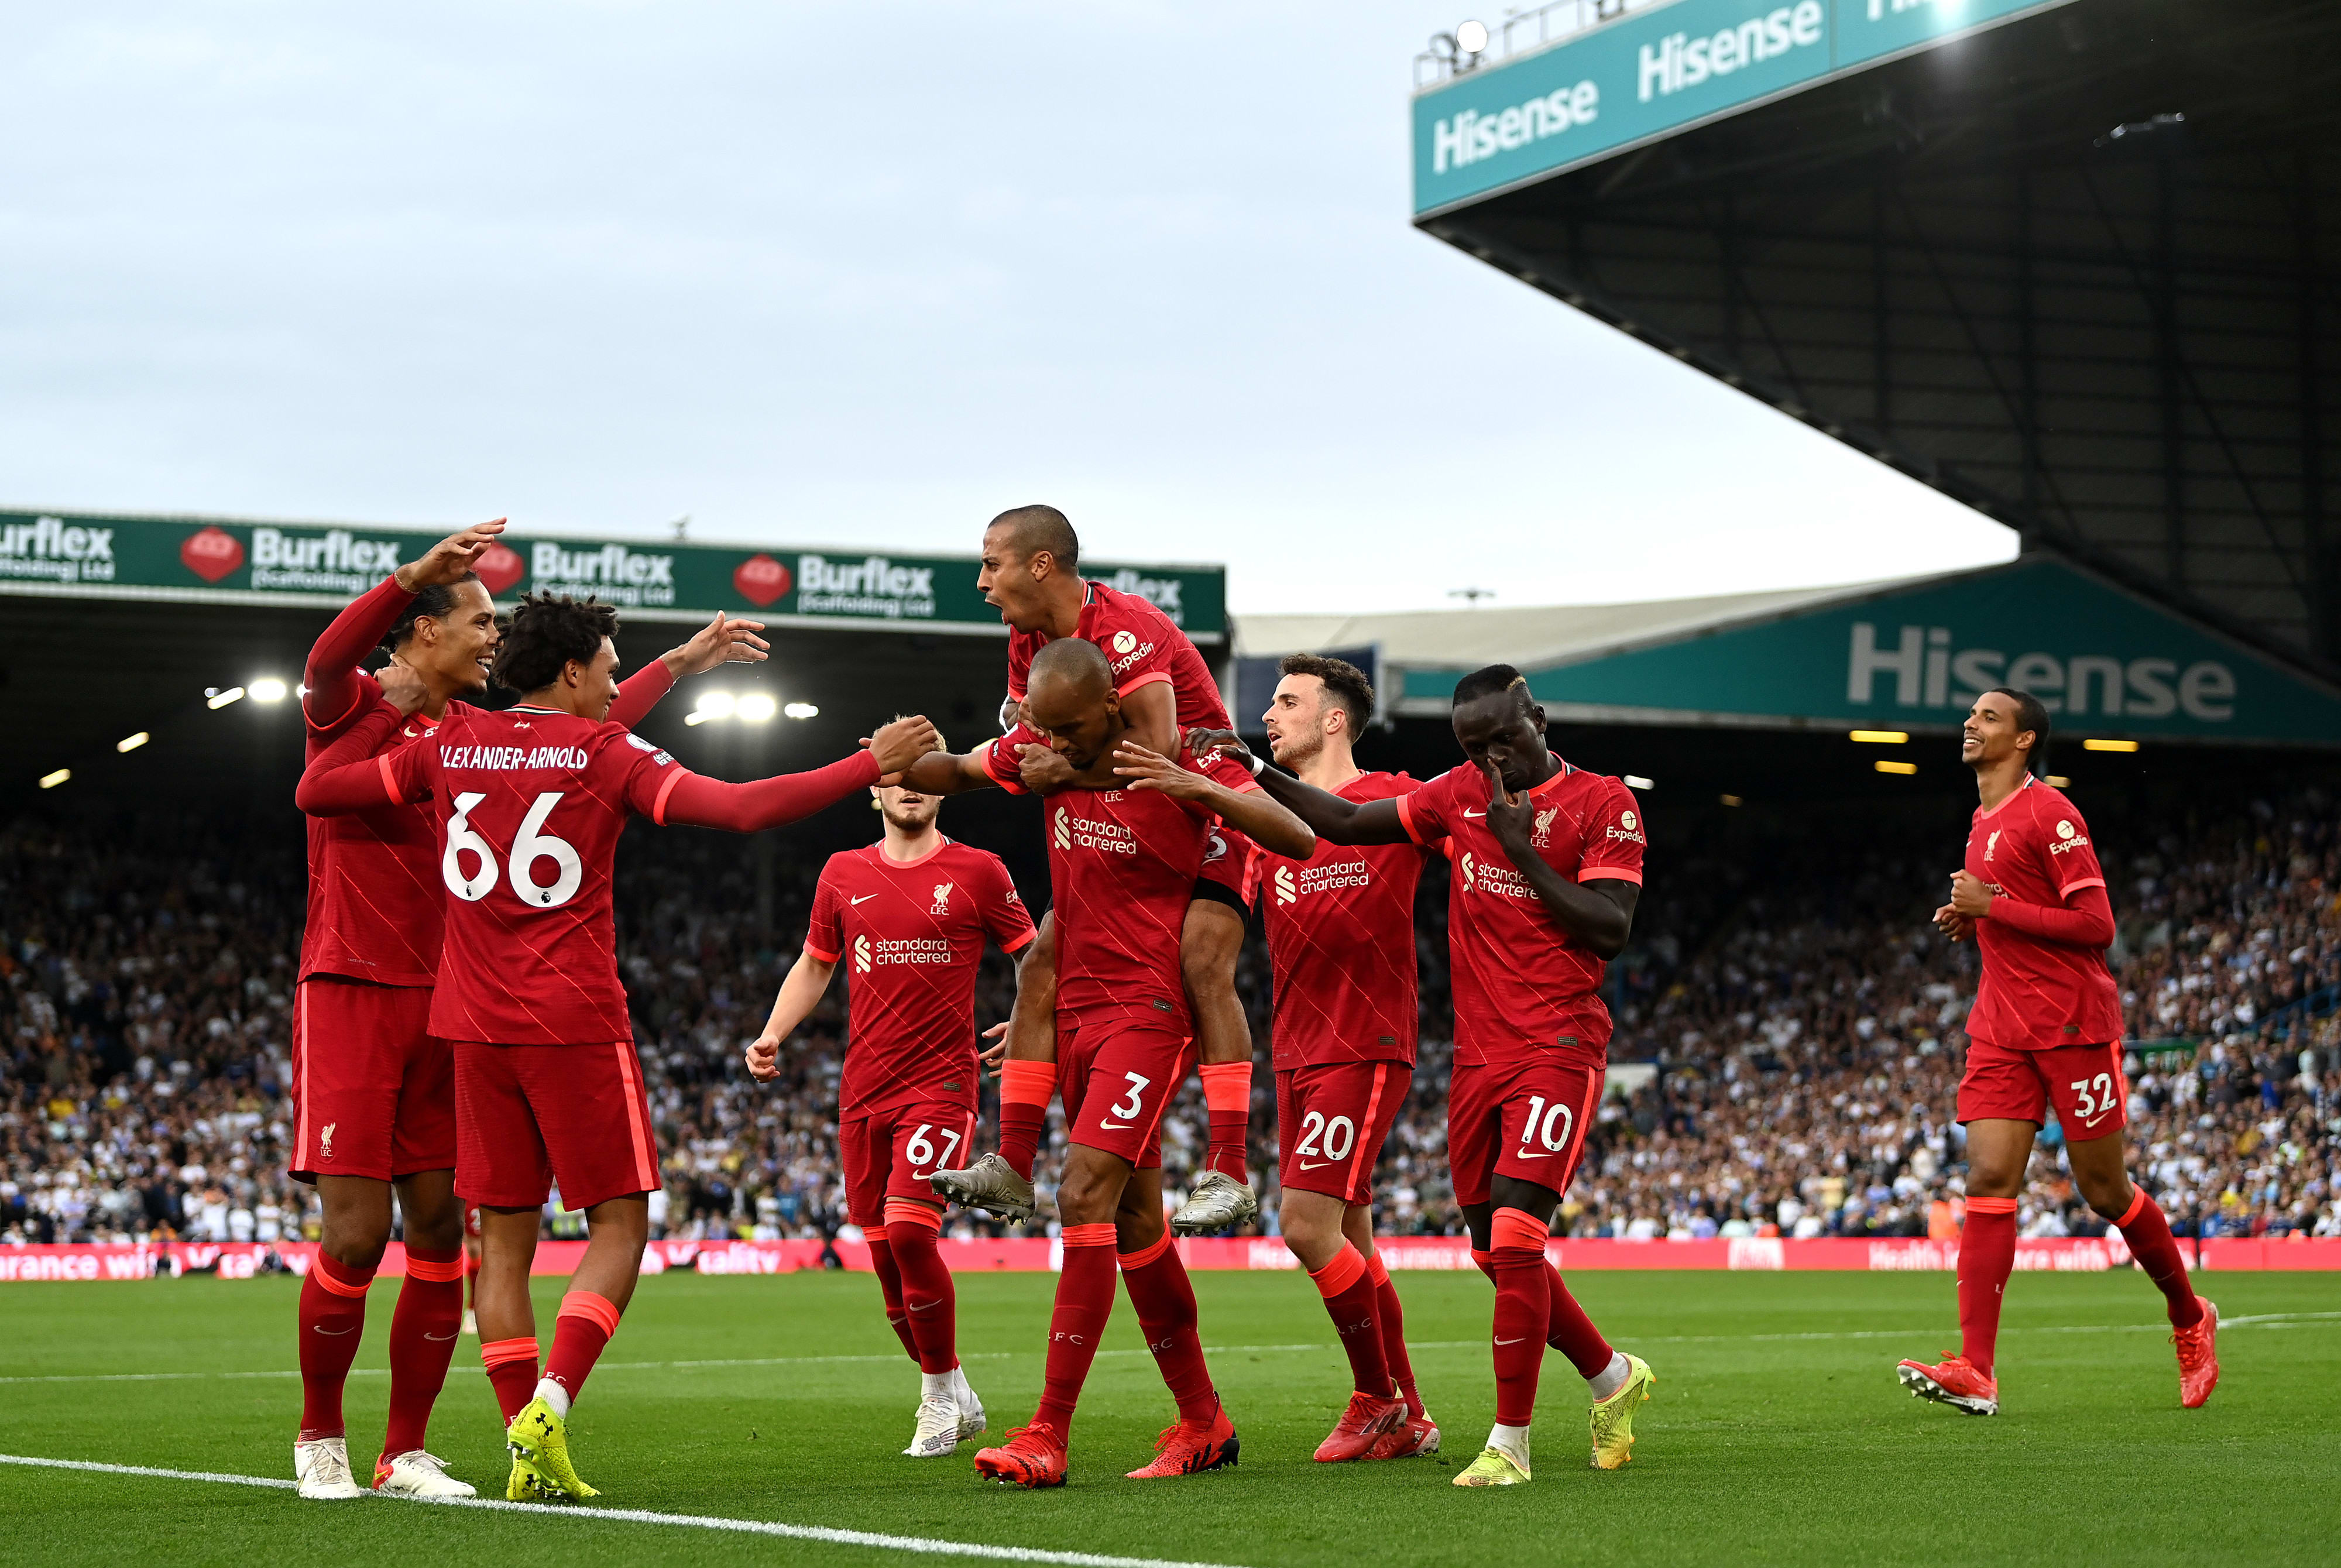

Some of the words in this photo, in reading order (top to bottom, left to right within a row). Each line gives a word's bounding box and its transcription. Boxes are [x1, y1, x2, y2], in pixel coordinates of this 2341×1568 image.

[1638, 0, 1824, 102] Hisense
[1432, 79, 1599, 174] Hisense
[0, 515, 116, 560] urflex
[252, 528, 401, 573] Burflex
[531, 542, 675, 585] Burflex
[797, 554, 935, 598] Burflex
[1847, 622, 2236, 720] Hisense
[442, 791, 582, 908] 66
[1607, 826, 1644, 844] Expedia
[2048, 835, 2088, 855] Expedia
[1300, 860, 1365, 881] standard
[1300, 873, 1369, 894] chartered
[1478, 877, 1539, 900] chartere
[876, 937, 947, 952] standard
[876, 951, 950, 965] chartered
[1110, 1071, 1151, 1120] 3
[2070, 1072, 2116, 1119] 32
[1295, 1111, 1355, 1161] 20
[1521, 1095, 1573, 1152] 10
[905, 1124, 962, 1169] 67
[1869, 1239, 1943, 1270] Health
[2053, 1239, 2110, 1271] with
[1151, 1337, 1173, 1353] FC
